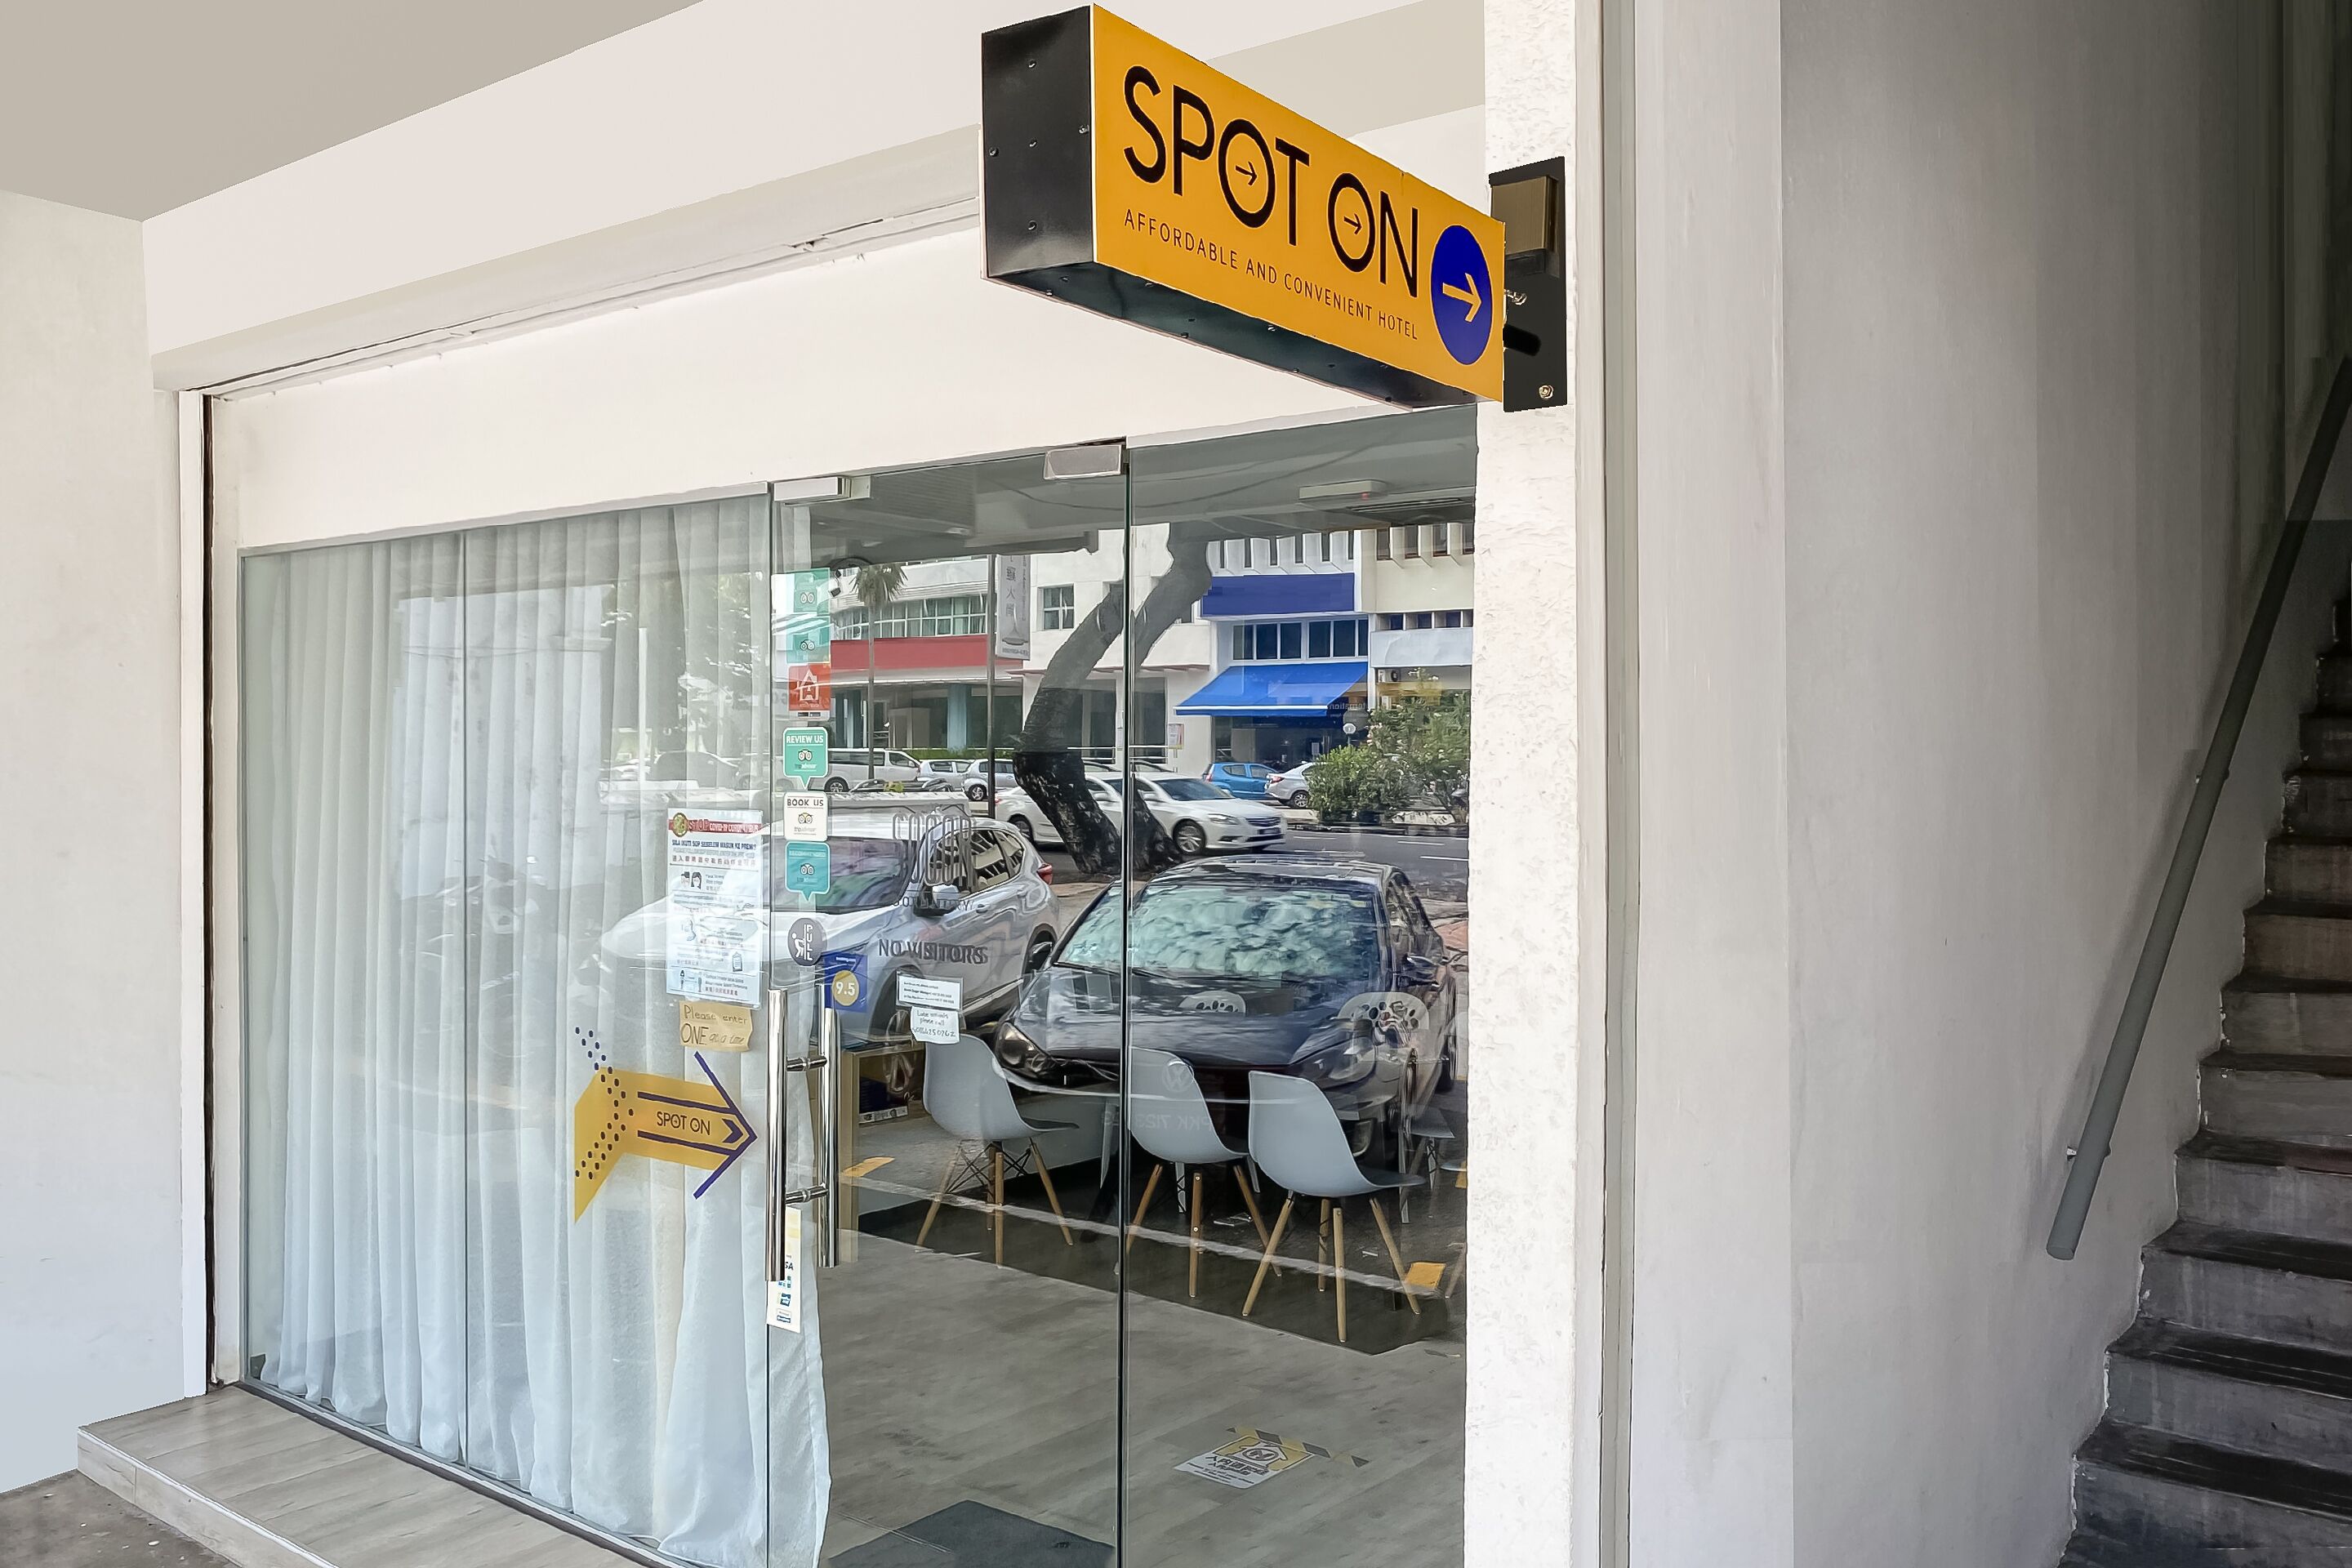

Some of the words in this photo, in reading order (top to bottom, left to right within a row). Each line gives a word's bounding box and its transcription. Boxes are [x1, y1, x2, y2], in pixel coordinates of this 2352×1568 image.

[1123, 65, 1310, 246] SPOT
[1327, 172, 1419, 298] ON
[1124, 207, 1238, 270] AFFORDABLE
[1245, 257, 1277, 284] AND
[1283, 273, 1373, 322] CONVENIENT
[1379, 310, 1418, 340] HOTEL
[786, 735, 812, 743] REVIEW
[813, 735, 823, 743] US
[786, 798, 809, 806] BOOK
[813, 799, 824, 807] US
[806, 924, 814, 961] PULL
[879, 938, 902, 957] NO
[906, 940, 989, 964] VISITORS
[835, 982, 855, 996] 9.5
[684, 1004, 716, 1020] Please
[722, 1015, 748, 1024] enter
[680, 1022, 709, 1045] ONE
[657, 1111, 688, 1129] SPOT
[690, 1117, 710, 1136] ON
